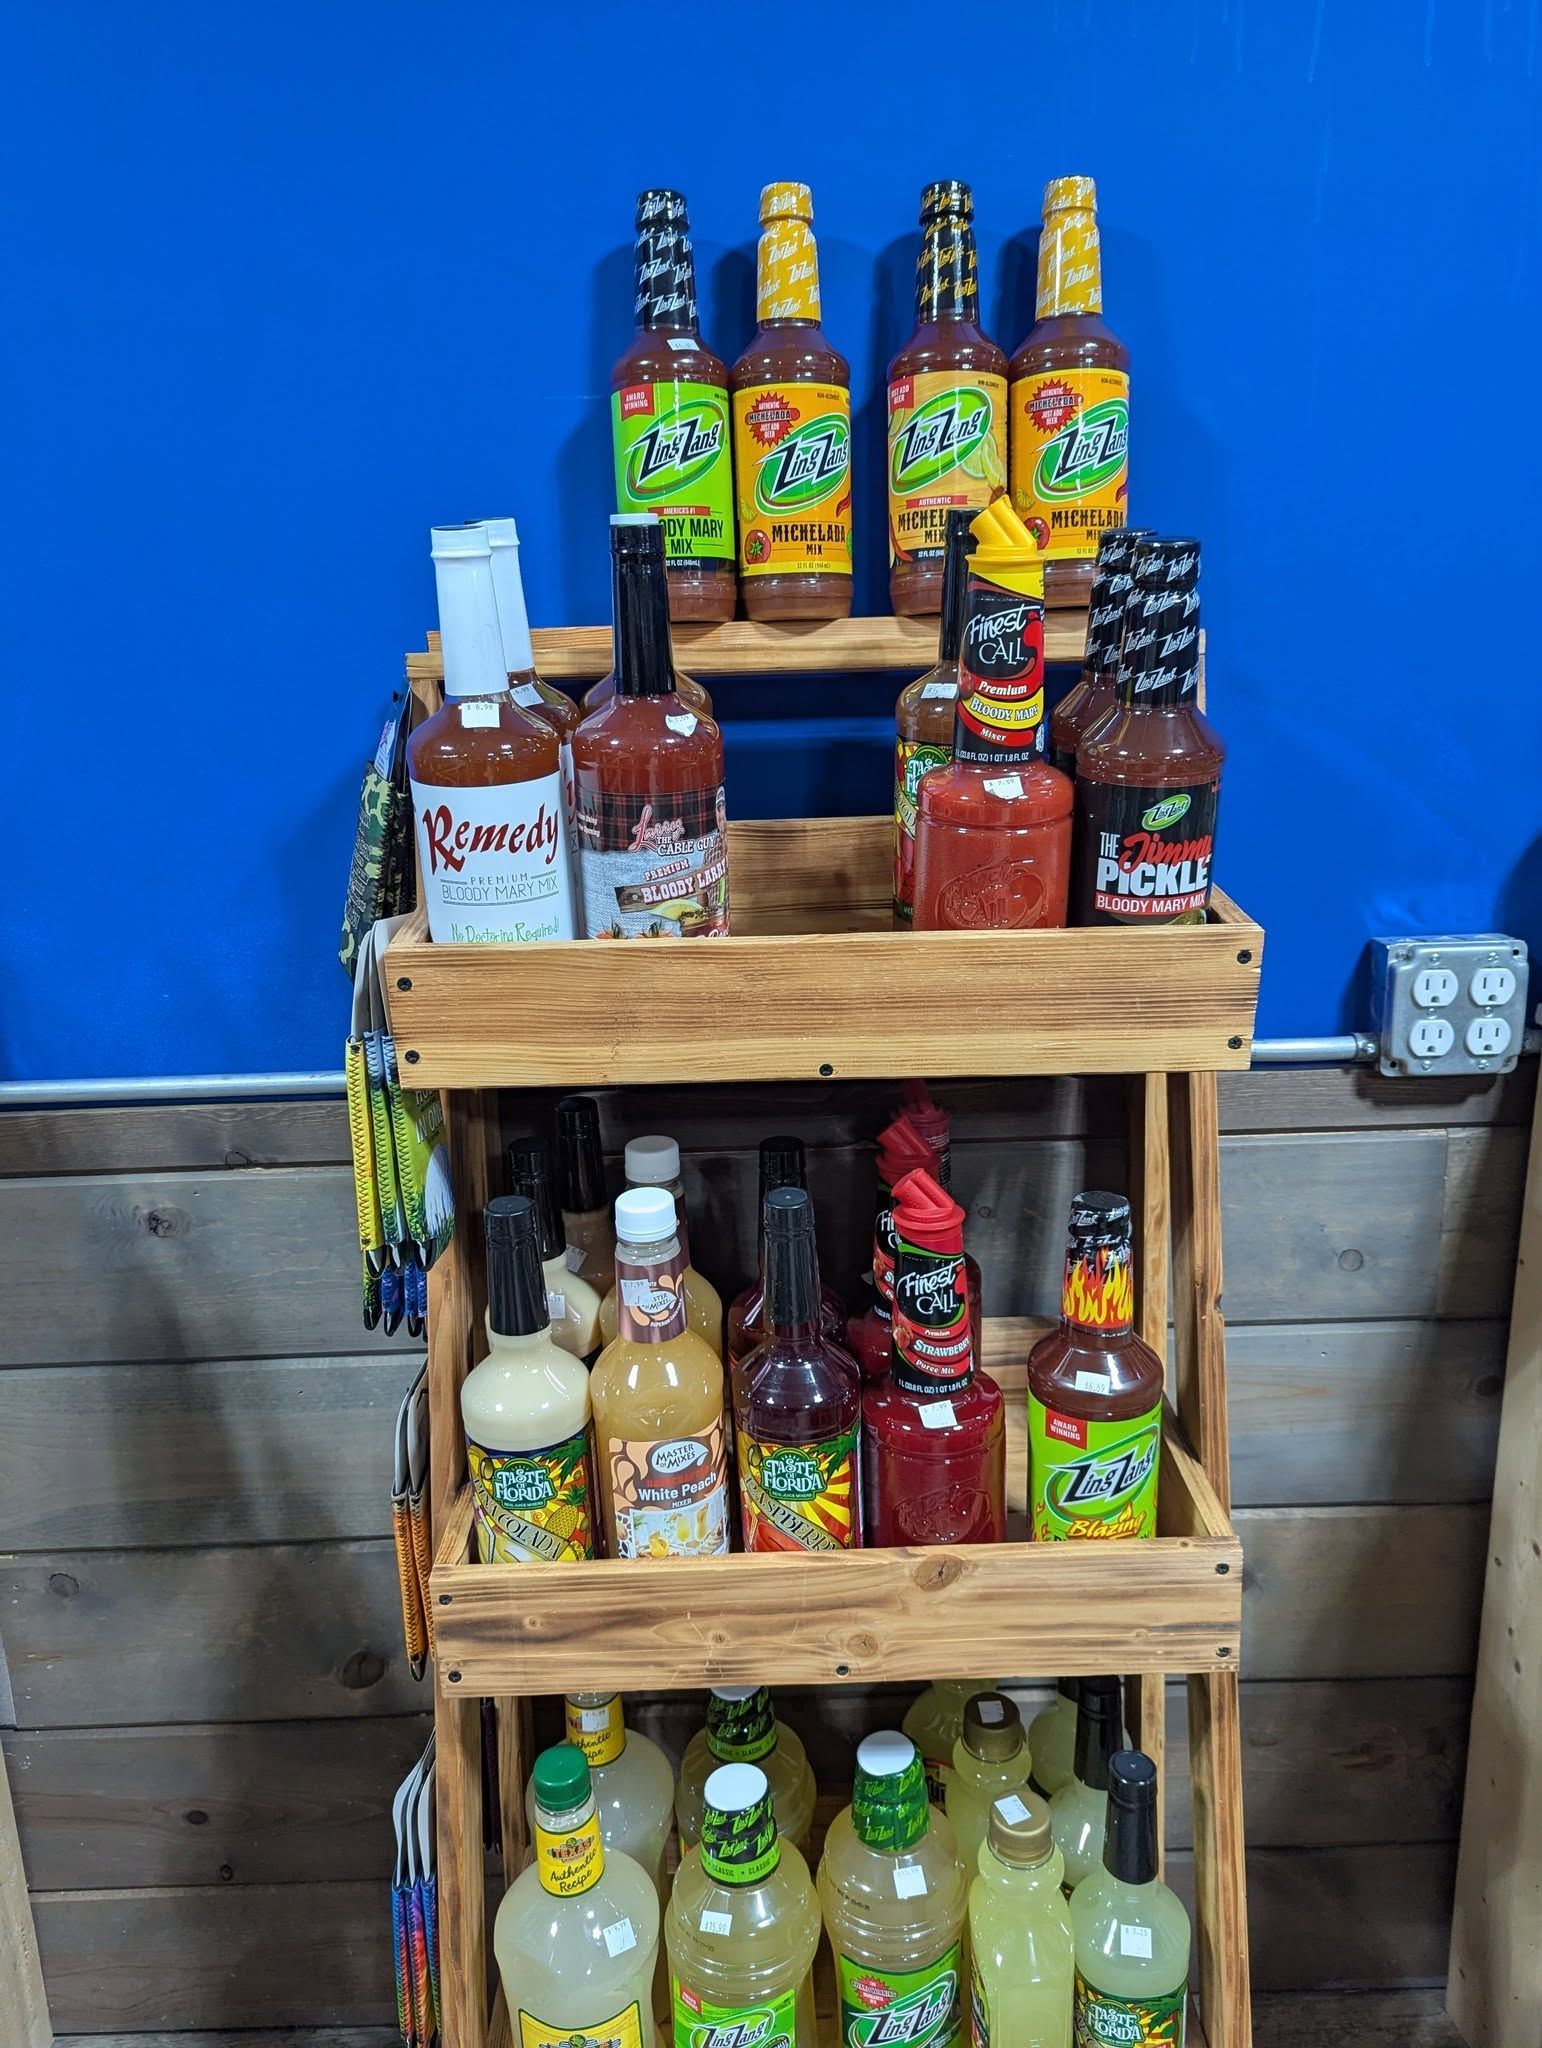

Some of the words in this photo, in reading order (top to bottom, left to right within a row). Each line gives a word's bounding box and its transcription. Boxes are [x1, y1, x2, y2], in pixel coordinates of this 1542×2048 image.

[919, 497, 951, 506] AUTHENTIC
[690, 518, 723, 538] MARY
[898, 509, 946, 532] MICHEL
[772, 524, 845, 543] MICHELADA
[671, 538, 693, 554] MIX
[806, 544, 822, 555] MIX
[963, 603, 1041, 645] Finest
[979, 639, 1026, 665] CALL
[979, 681, 1028, 697] Premium
[971, 697, 1012, 721] BLOODY
[981, 727, 1006, 744] Mixer
[1022, 752, 1029, 761] OZ
[422, 803, 559, 875] Remedy
[658, 841, 694, 856] CABLE
[697, 835, 717, 853] GUY
[1100, 832, 1120, 858] THE
[471, 873, 533, 886] PREMIUM
[645, 859, 690, 881] PREMIUM
[1096, 856, 1211, 897] PICKLE
[441, 885, 489, 901] BLOODY
[496, 880, 533, 900] MARY
[539, 876, 559, 894] MIX
[641, 878, 695, 904] BLOODY
[1098, 896, 1150, 912] BLOODY
[1152, 898, 1188, 913] MARY
[1190, 893, 1206, 908] MIX
[897, 1258, 964, 1297] Finest
[652, 1292, 668, 1303] STER
[917, 1290, 959, 1314] CALL
[924, 1329, 950, 1338] Premium
[941, 1365, 955, 1374] Mix
[1050, 1425, 1081, 1441] WINNING
[1053, 1418, 1078, 1431] AWARD
[655, 1443, 694, 1465] MASTER
[667, 1452, 696, 1469] MIXES
[497, 1468, 547, 1487] TASTE
[767, 1459, 817, 1478] TASTE
[495, 1480, 554, 1502] FLORIDA
[515, 1483, 528, 1491] OF
[638, 1485, 679, 1501] White
[681, 1471, 717, 1496] Peach
[765, 1469, 823, 1493] FLORIDA
[672, 1498, 692, 1509] MIXER
[744, 1477, 835, 1551] RASPBERR
[1068, 1511, 1145, 1540] Blazing
[497, 1513, 562, 1560] COLADA
[553, 1839, 593, 1858] TEXAS
[551, 1849, 597, 1881] Authentic
[749, 1855, 770, 1875] CLASSIC
[559, 1869, 593, 1892] Recipe
[1088, 2010, 1141, 2041] FLORIDA
[1090, 2003, 1138, 2027] TASTE
